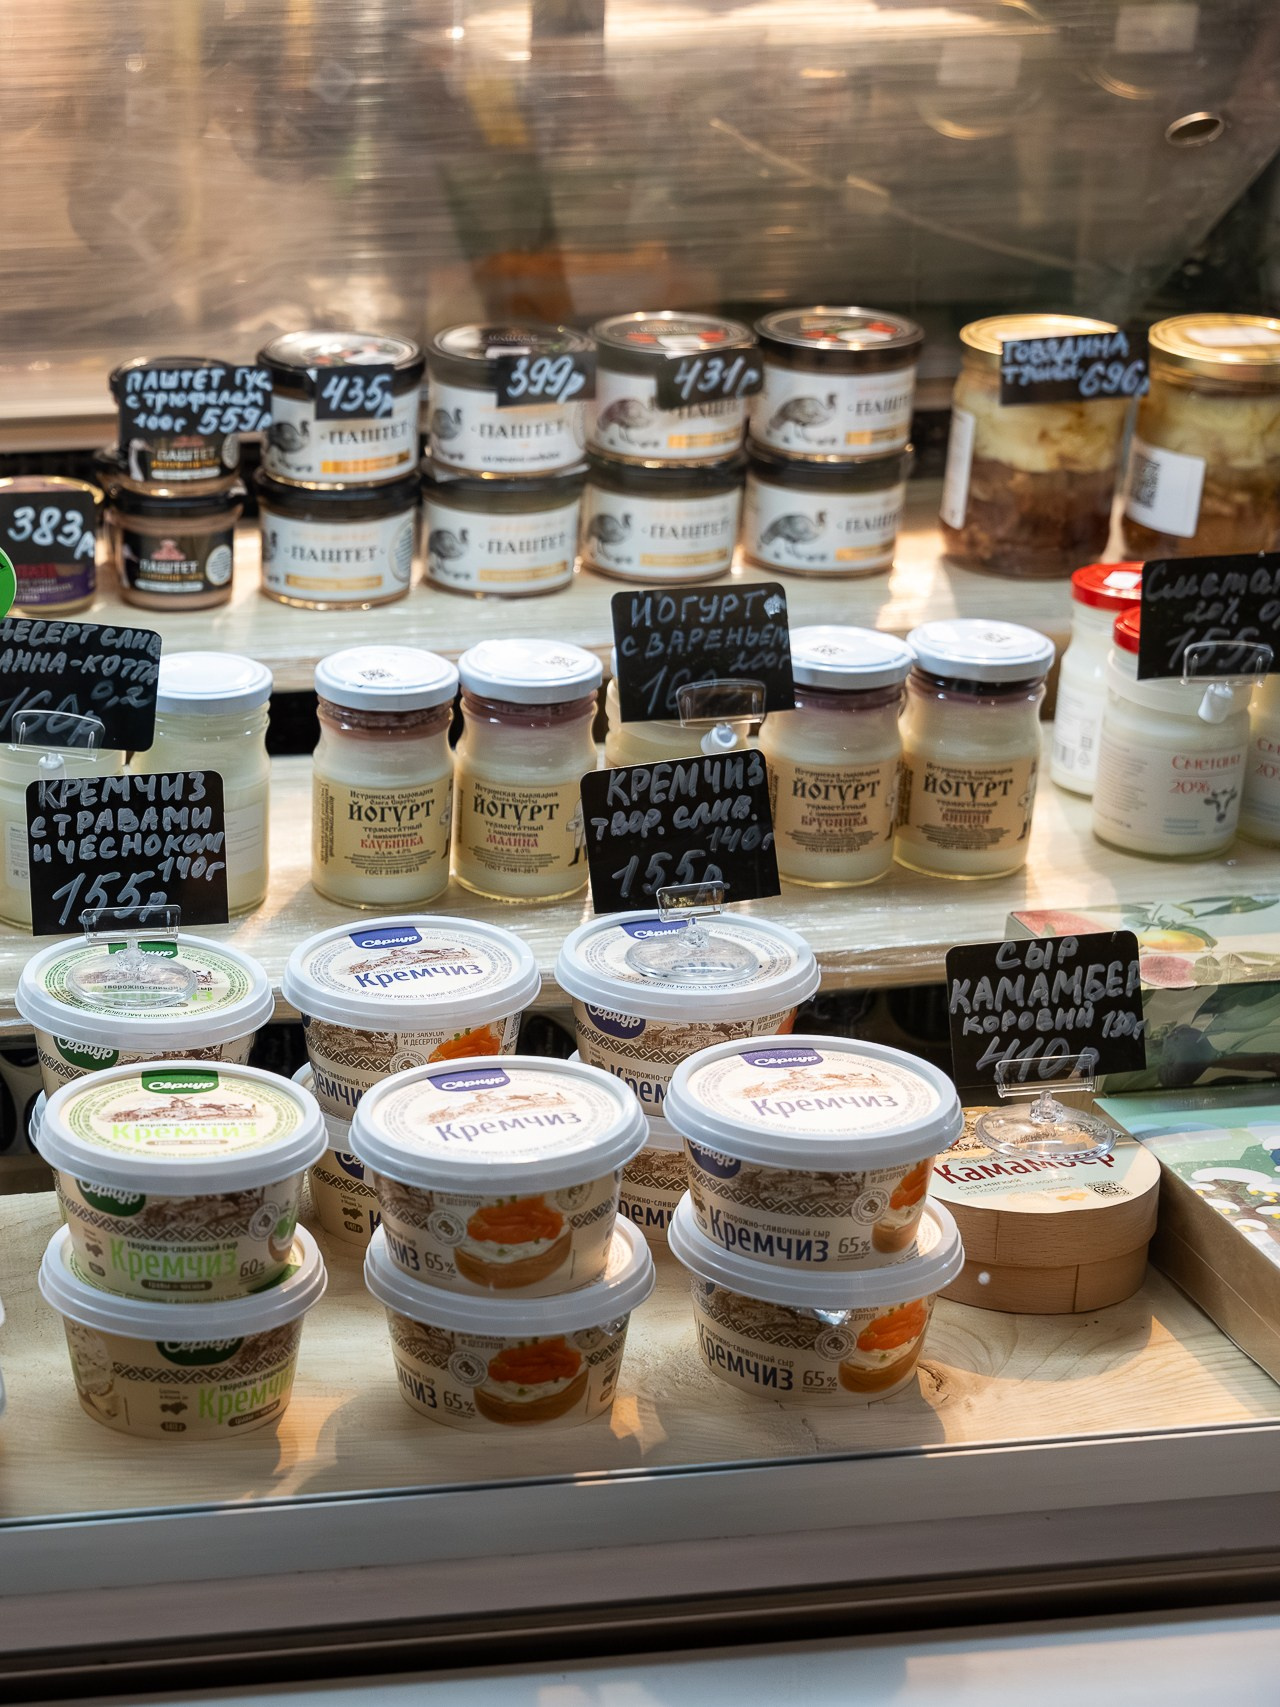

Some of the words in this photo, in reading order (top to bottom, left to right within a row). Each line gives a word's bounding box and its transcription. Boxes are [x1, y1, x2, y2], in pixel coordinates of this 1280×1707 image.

[126, 368, 226, 393] ПАШТЕТ
[506, 355, 586, 403] 399р
[674, 357, 760, 399] 431р
[322, 374, 394, 418] 435р
[631, 590, 767, 627] ЙОГУРТ
[644, 624, 789, 659] ВАРЕНЬЕМ
[38, 771, 206, 810] КРЕМЧИЗ
[606, 752, 764, 807] КРЕМЧИЗ
[792, 778, 880, 806] ЙОГУРТ
[923, 773, 1013, 806] ЙОГУРТ
[53, 806, 212, 836] ТРАВАМИ
[348, 799, 435, 827] ЙОГУРТ
[474, 794, 560, 829] ЙОГУРТ
[58, 832, 224, 864] ЧЕСНОКОМ
[360, 836, 423, 851] КЛУБНИКА
[486, 834, 538, 848] МАЛИНА
[158, 855, 225, 882] 140г
[52, 871, 167, 926] 155р
[361, 934, 418, 949] Сернур
[996, 936, 1079, 970] СЫР
[354, 963, 484, 989] Кремчиз
[588, 1003, 640, 1028] Сернур
[963, 1000, 1095, 1036] КОРОВИЙ
[410, 1037, 443, 1046] ДЕСЕРТОВ
[753, 1054, 818, 1066] Сернур
[148, 1081, 216, 1092] Сернур
[442, 1075, 505, 1090] Сернур
[751, 1094, 898, 1119] Кремчиз
[112, 1123, 258, 1144] Кремчиз
[436, 1110, 582, 1142] Кремчиз
[709, 1205, 829, 1263] Кремчиз
[838, 1236, 870, 1254] 65%
[722, 1210, 810, 1237] творожно-сливочный
[813, 1230, 830, 1239] сыр
[110, 1237, 238, 1281] Кремчиз
[222, 1241, 238, 1251] сыр
[425, 1254, 456, 1276] 65%
[698, 1320, 793, 1391] Кремчиз
[802, 1370, 838, 1388] 65%
[778, 1359, 794, 1368] сыр
[443, 1390, 476, 1414] 65%
